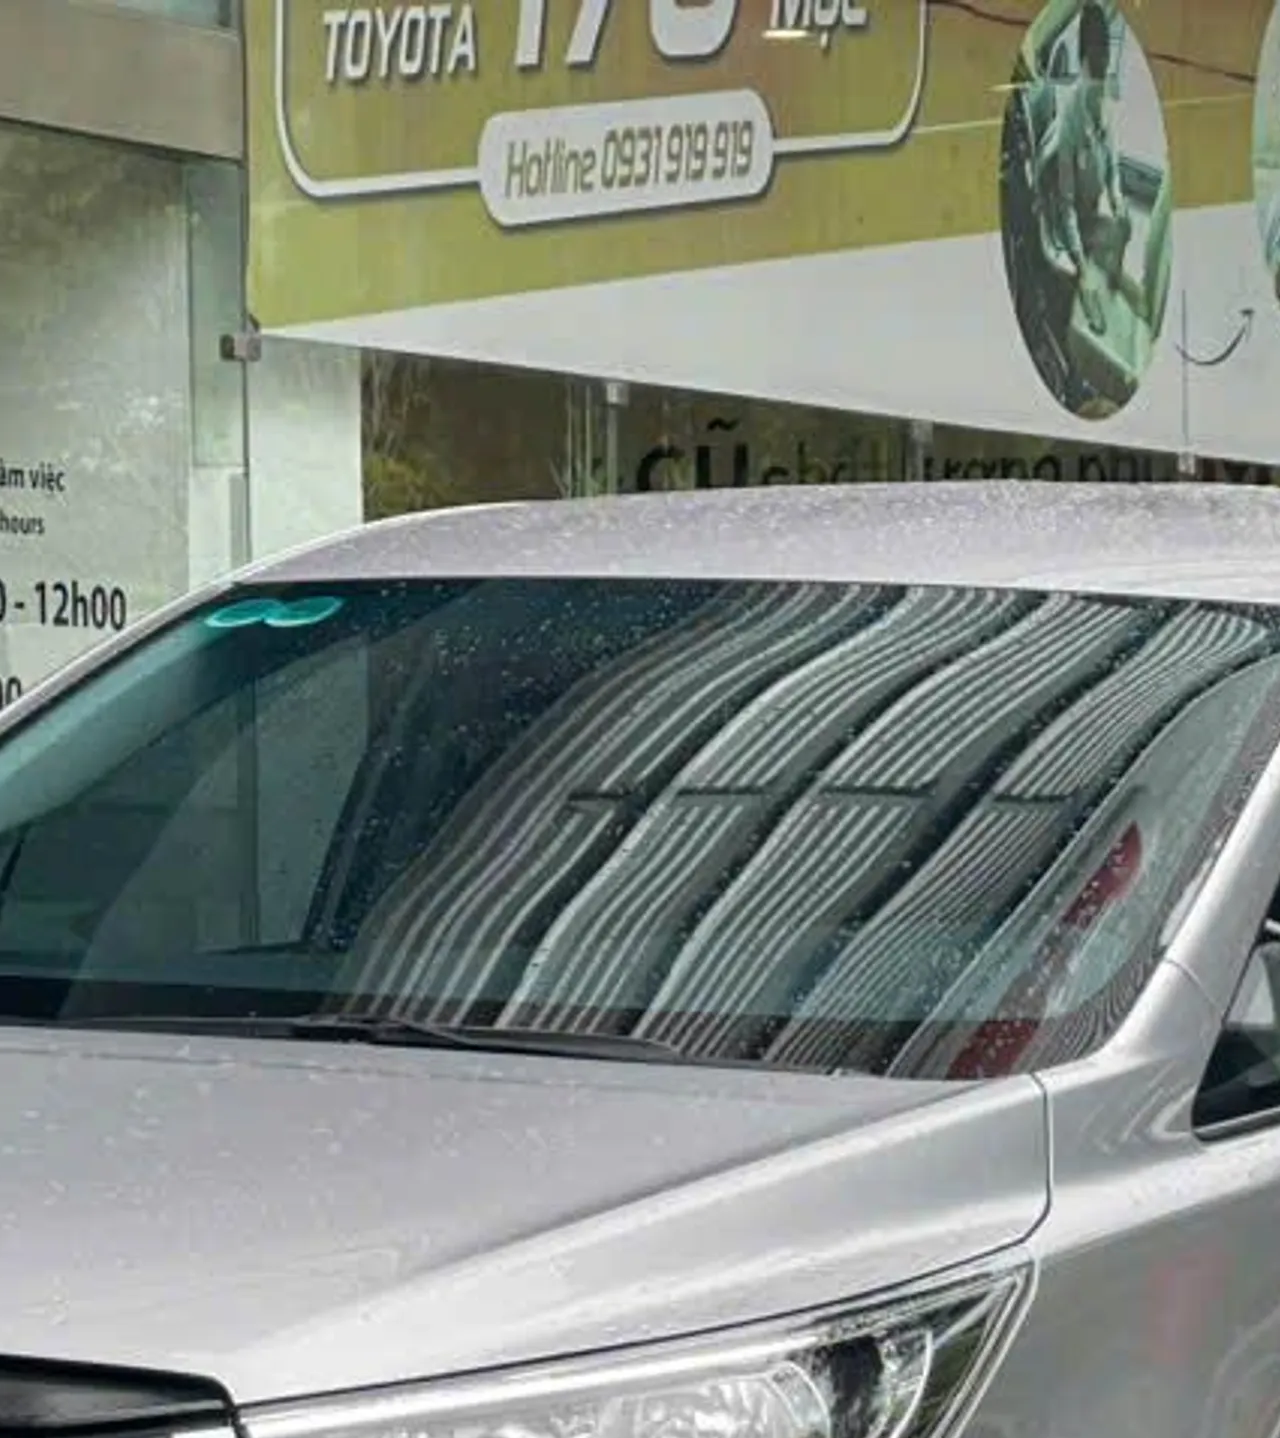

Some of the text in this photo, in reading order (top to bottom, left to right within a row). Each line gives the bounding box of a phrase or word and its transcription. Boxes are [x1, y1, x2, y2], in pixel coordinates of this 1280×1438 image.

[323, 2, 477, 82] TOYOTA
[505, 136, 597, 200] Hotline
[34, 578, 128, 632] 12h00
